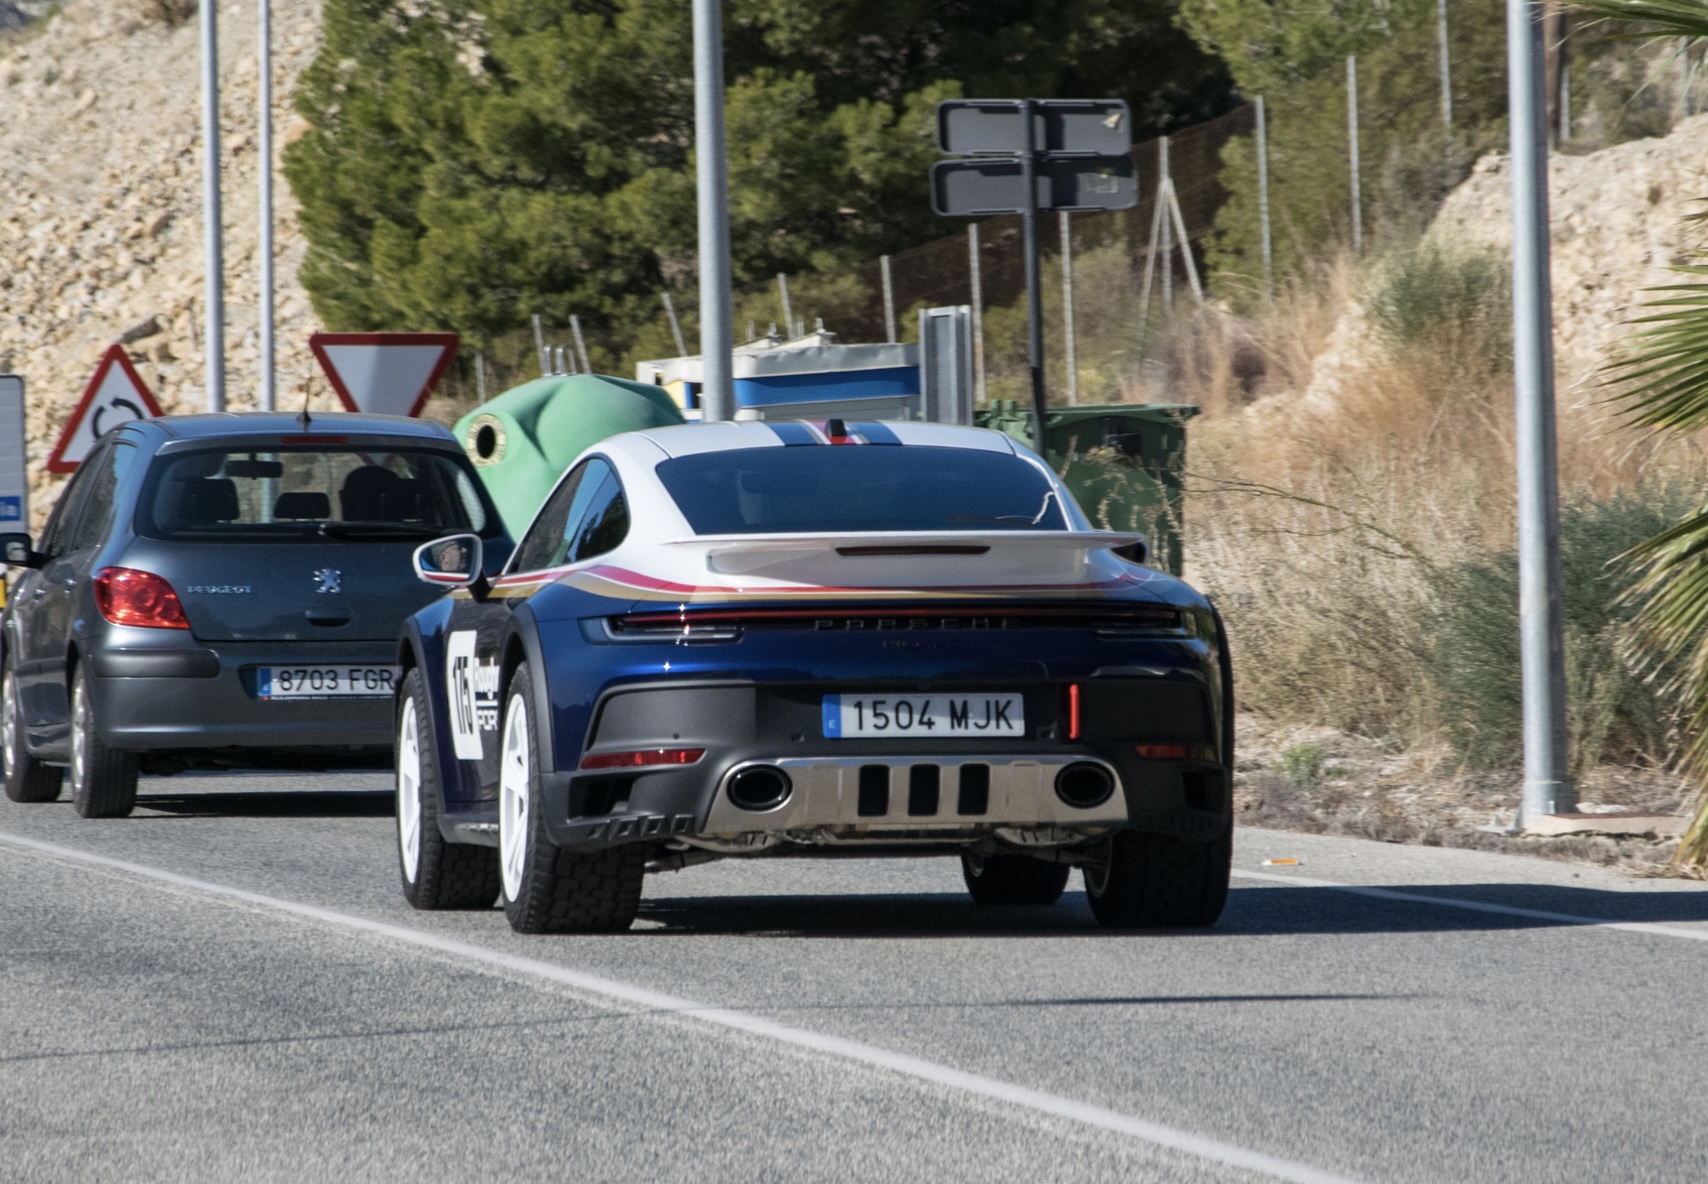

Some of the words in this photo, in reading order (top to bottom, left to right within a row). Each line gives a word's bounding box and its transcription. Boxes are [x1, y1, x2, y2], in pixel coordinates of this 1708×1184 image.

[187, 585, 253, 594] PEUGEOT
[814, 617, 1021, 631] PORSCHE
[279, 668, 339, 692] 8703
[348, 668, 395, 691] FGR
[853, 699, 936, 731] 1504
[949, 699, 1015, 731] MJK
[828, 719, 837, 730] E
